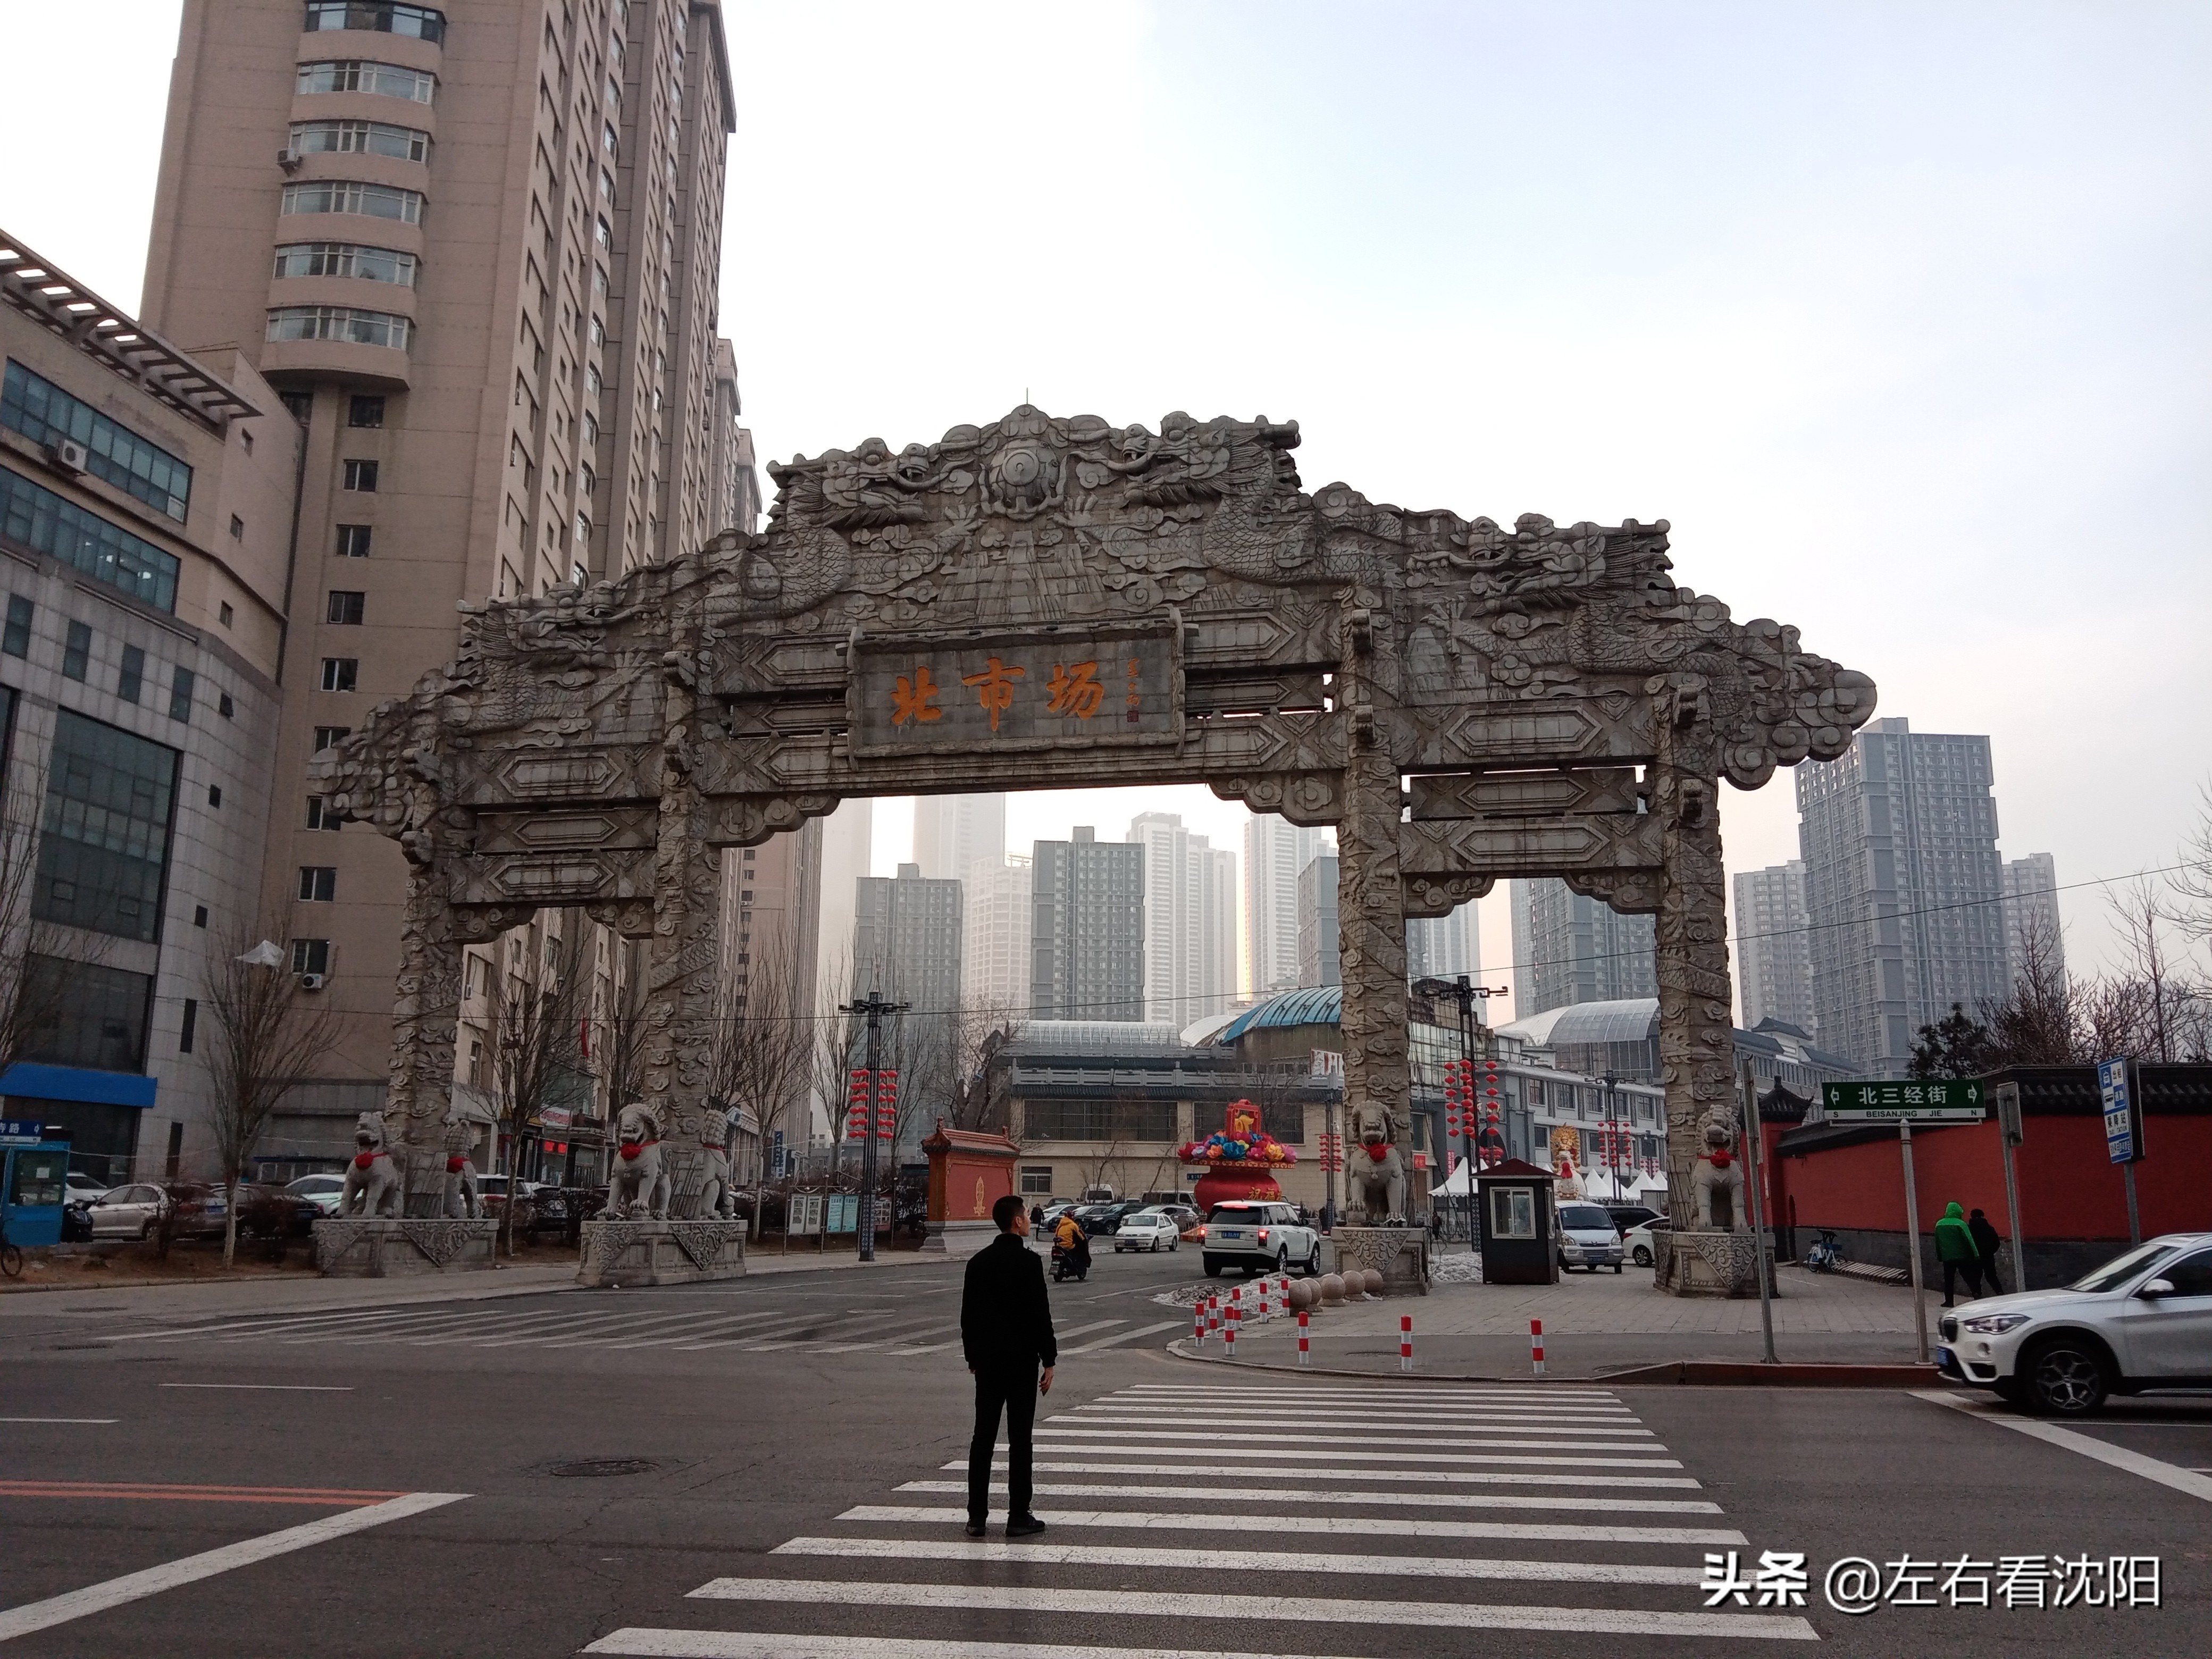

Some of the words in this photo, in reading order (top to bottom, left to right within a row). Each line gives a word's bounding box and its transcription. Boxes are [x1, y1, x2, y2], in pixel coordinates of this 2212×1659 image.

[891, 657, 1104, 731] 北市场
[1858, 1086, 1947, 1104] 北三经街
